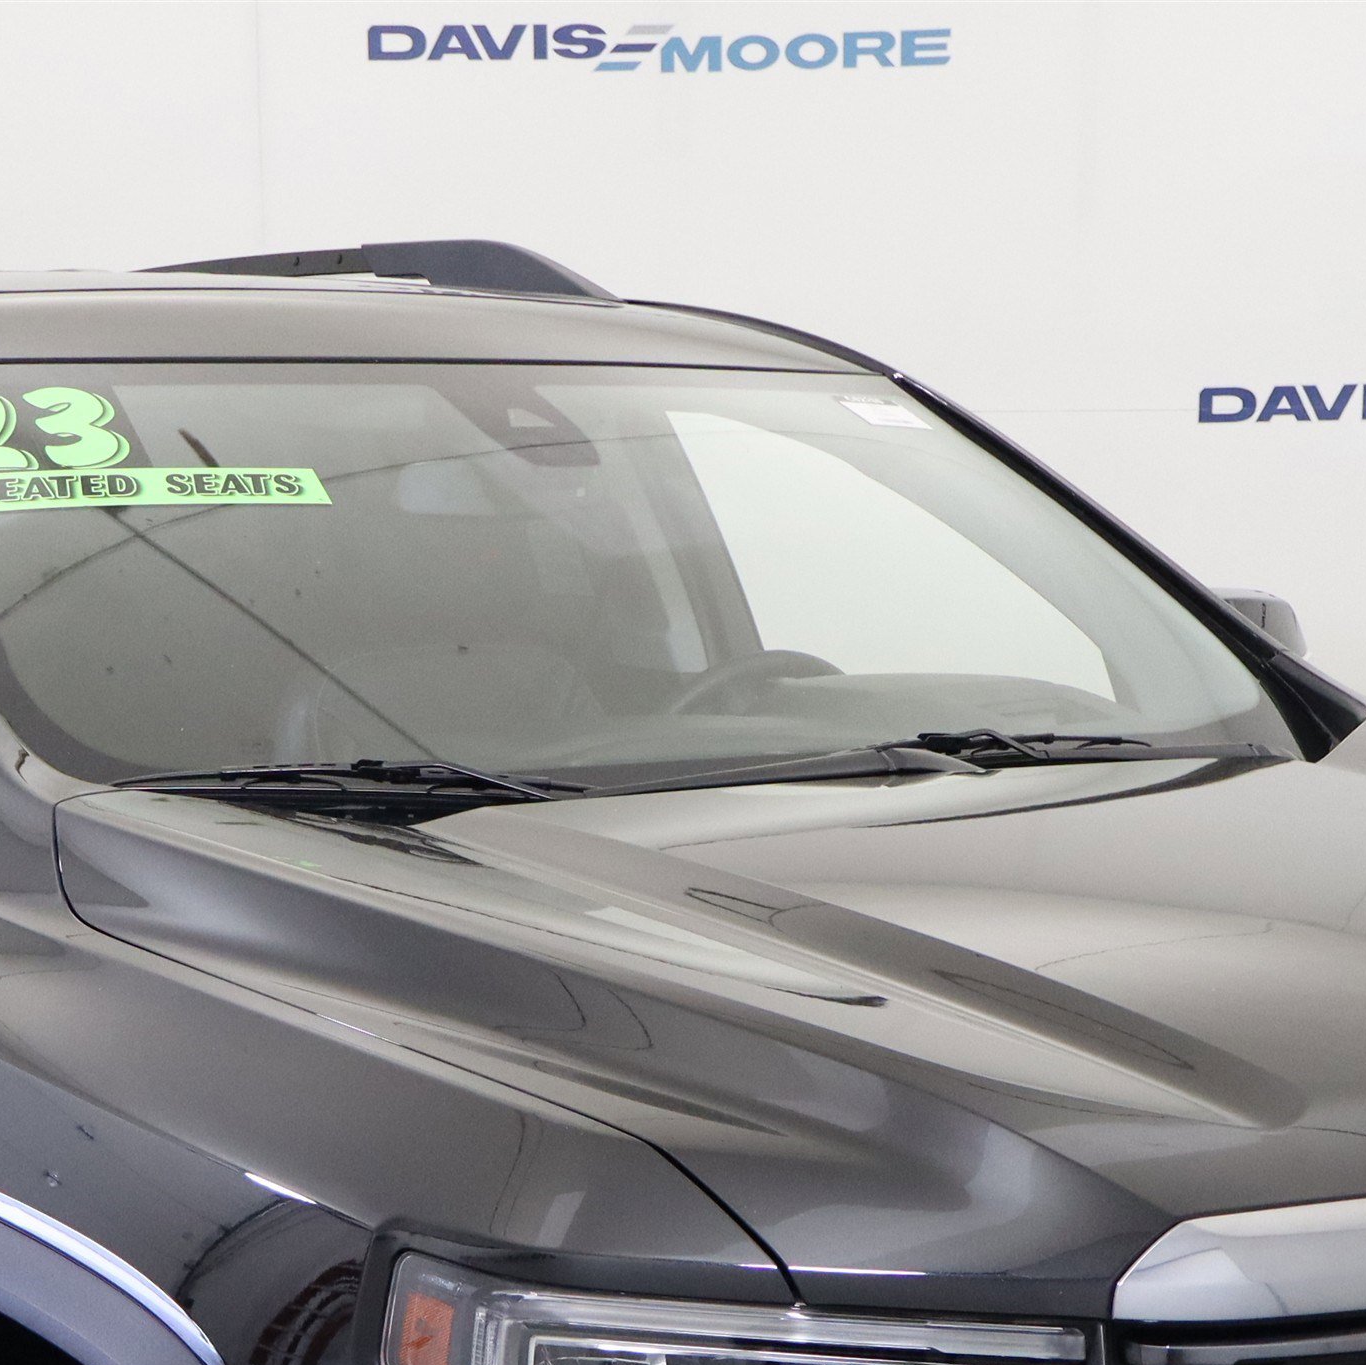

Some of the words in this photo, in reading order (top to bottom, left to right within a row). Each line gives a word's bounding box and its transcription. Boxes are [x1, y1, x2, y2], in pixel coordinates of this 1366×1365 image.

[367, 24, 608, 61] DAVIS
[659, 28, 952, 73] MOORE
[166, 472, 306, 498] SEATS
